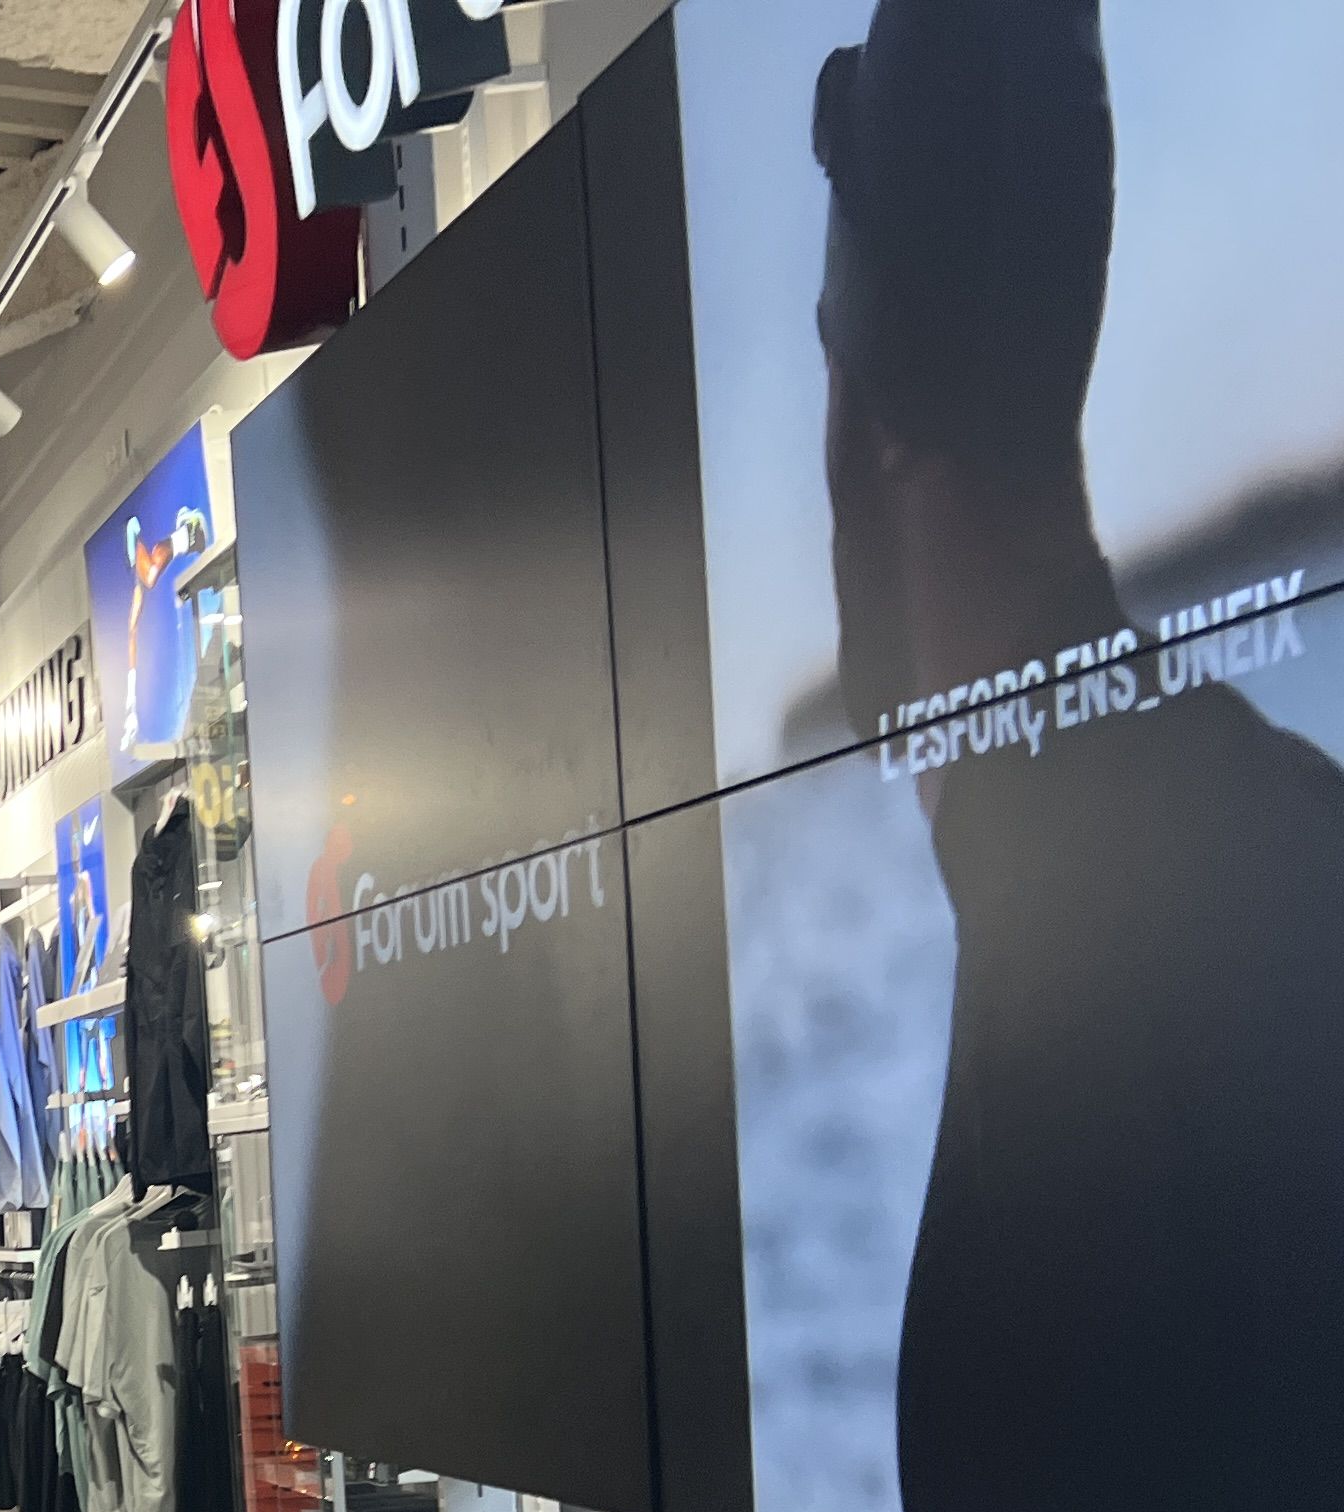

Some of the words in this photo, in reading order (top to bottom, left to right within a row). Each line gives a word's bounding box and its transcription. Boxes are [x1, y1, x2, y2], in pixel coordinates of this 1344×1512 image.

[878, 659, 1046, 783] L'ESFORÇ
[352, 869, 472, 973] forum
[480, 814, 605, 954] sport
